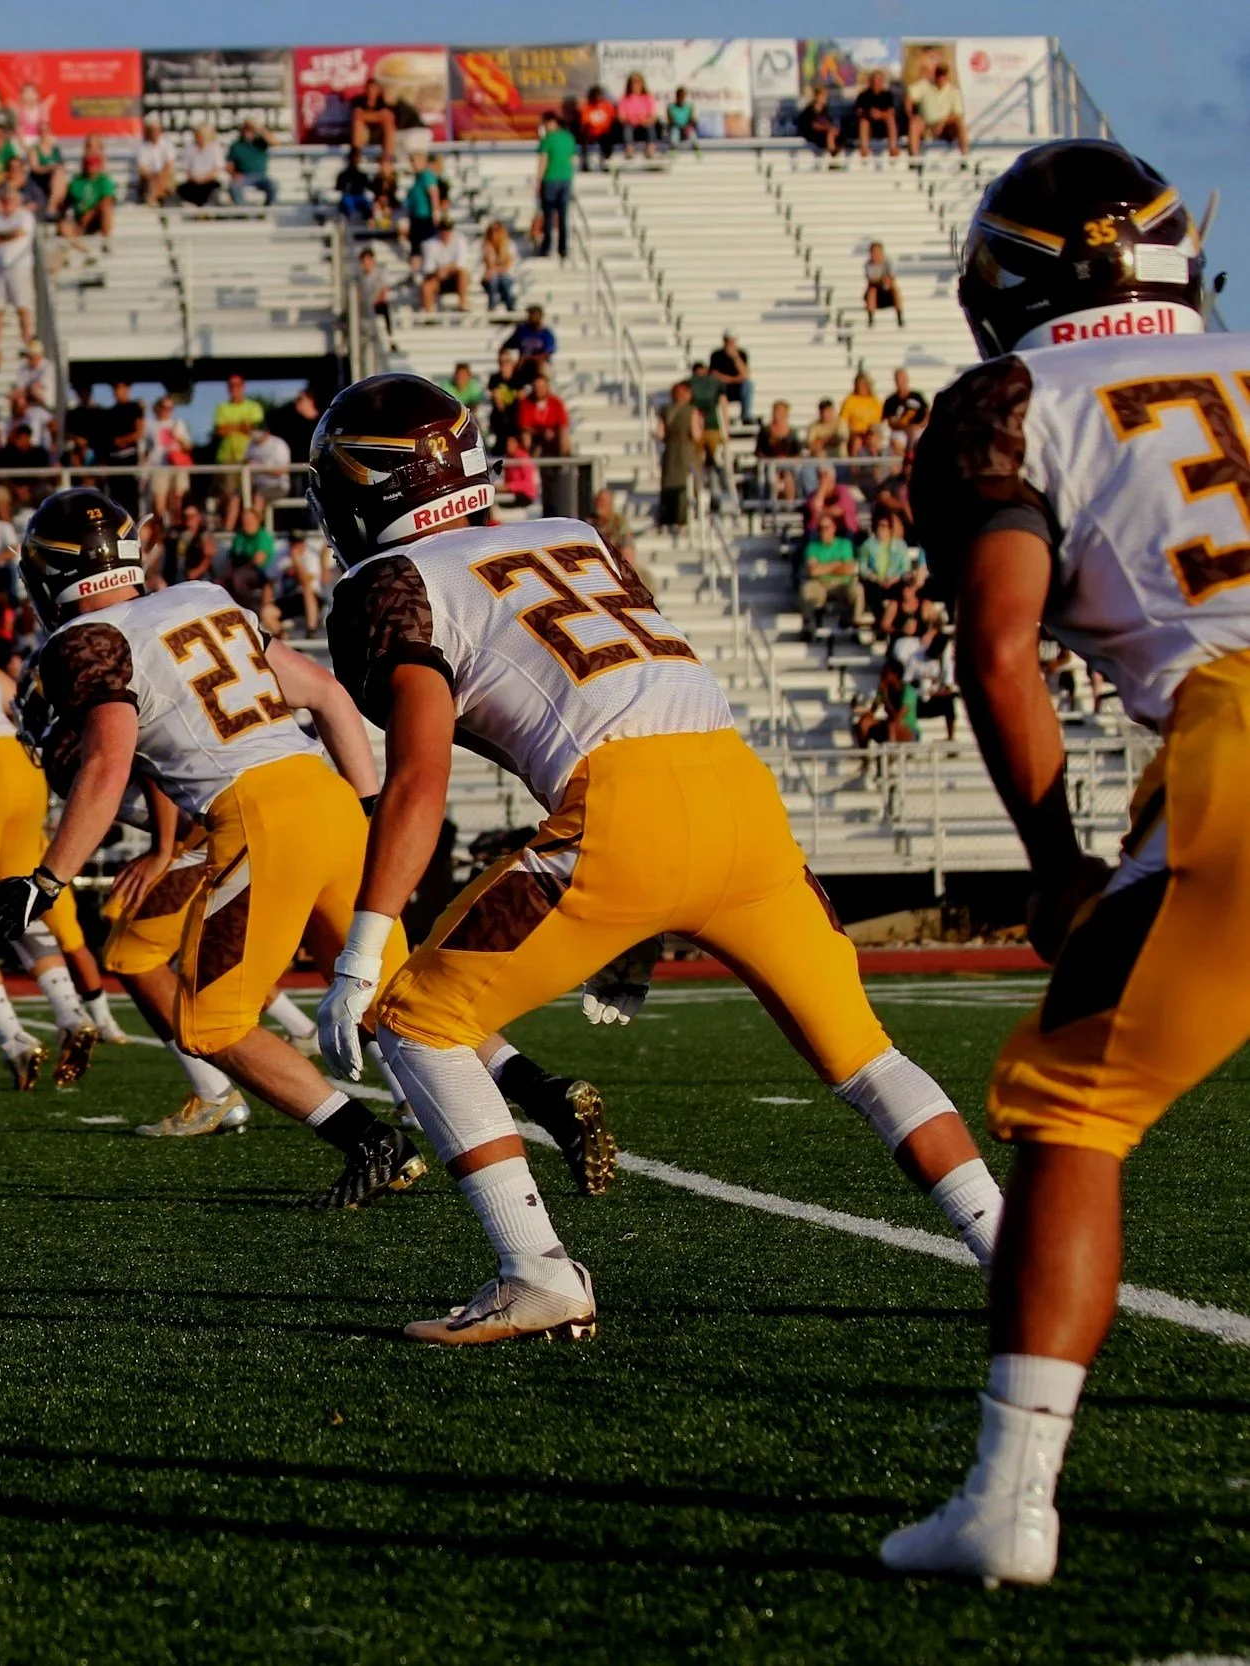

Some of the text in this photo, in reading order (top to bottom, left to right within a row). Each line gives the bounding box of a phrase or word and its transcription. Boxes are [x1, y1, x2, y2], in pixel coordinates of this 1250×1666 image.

[603, 44, 675, 62] Amazing
[1083, 217, 1118, 247] 35
[1051, 308, 1175, 345] Riddell
[428, 436, 449, 457] 22
[1094, 371, 1250, 607] 3
[86, 508, 103, 520] 23
[413, 488, 488, 530] Riddell
[78, 569, 137, 596] Riddell
[467, 541, 702, 688] 22
[159, 607, 293, 745] 23
